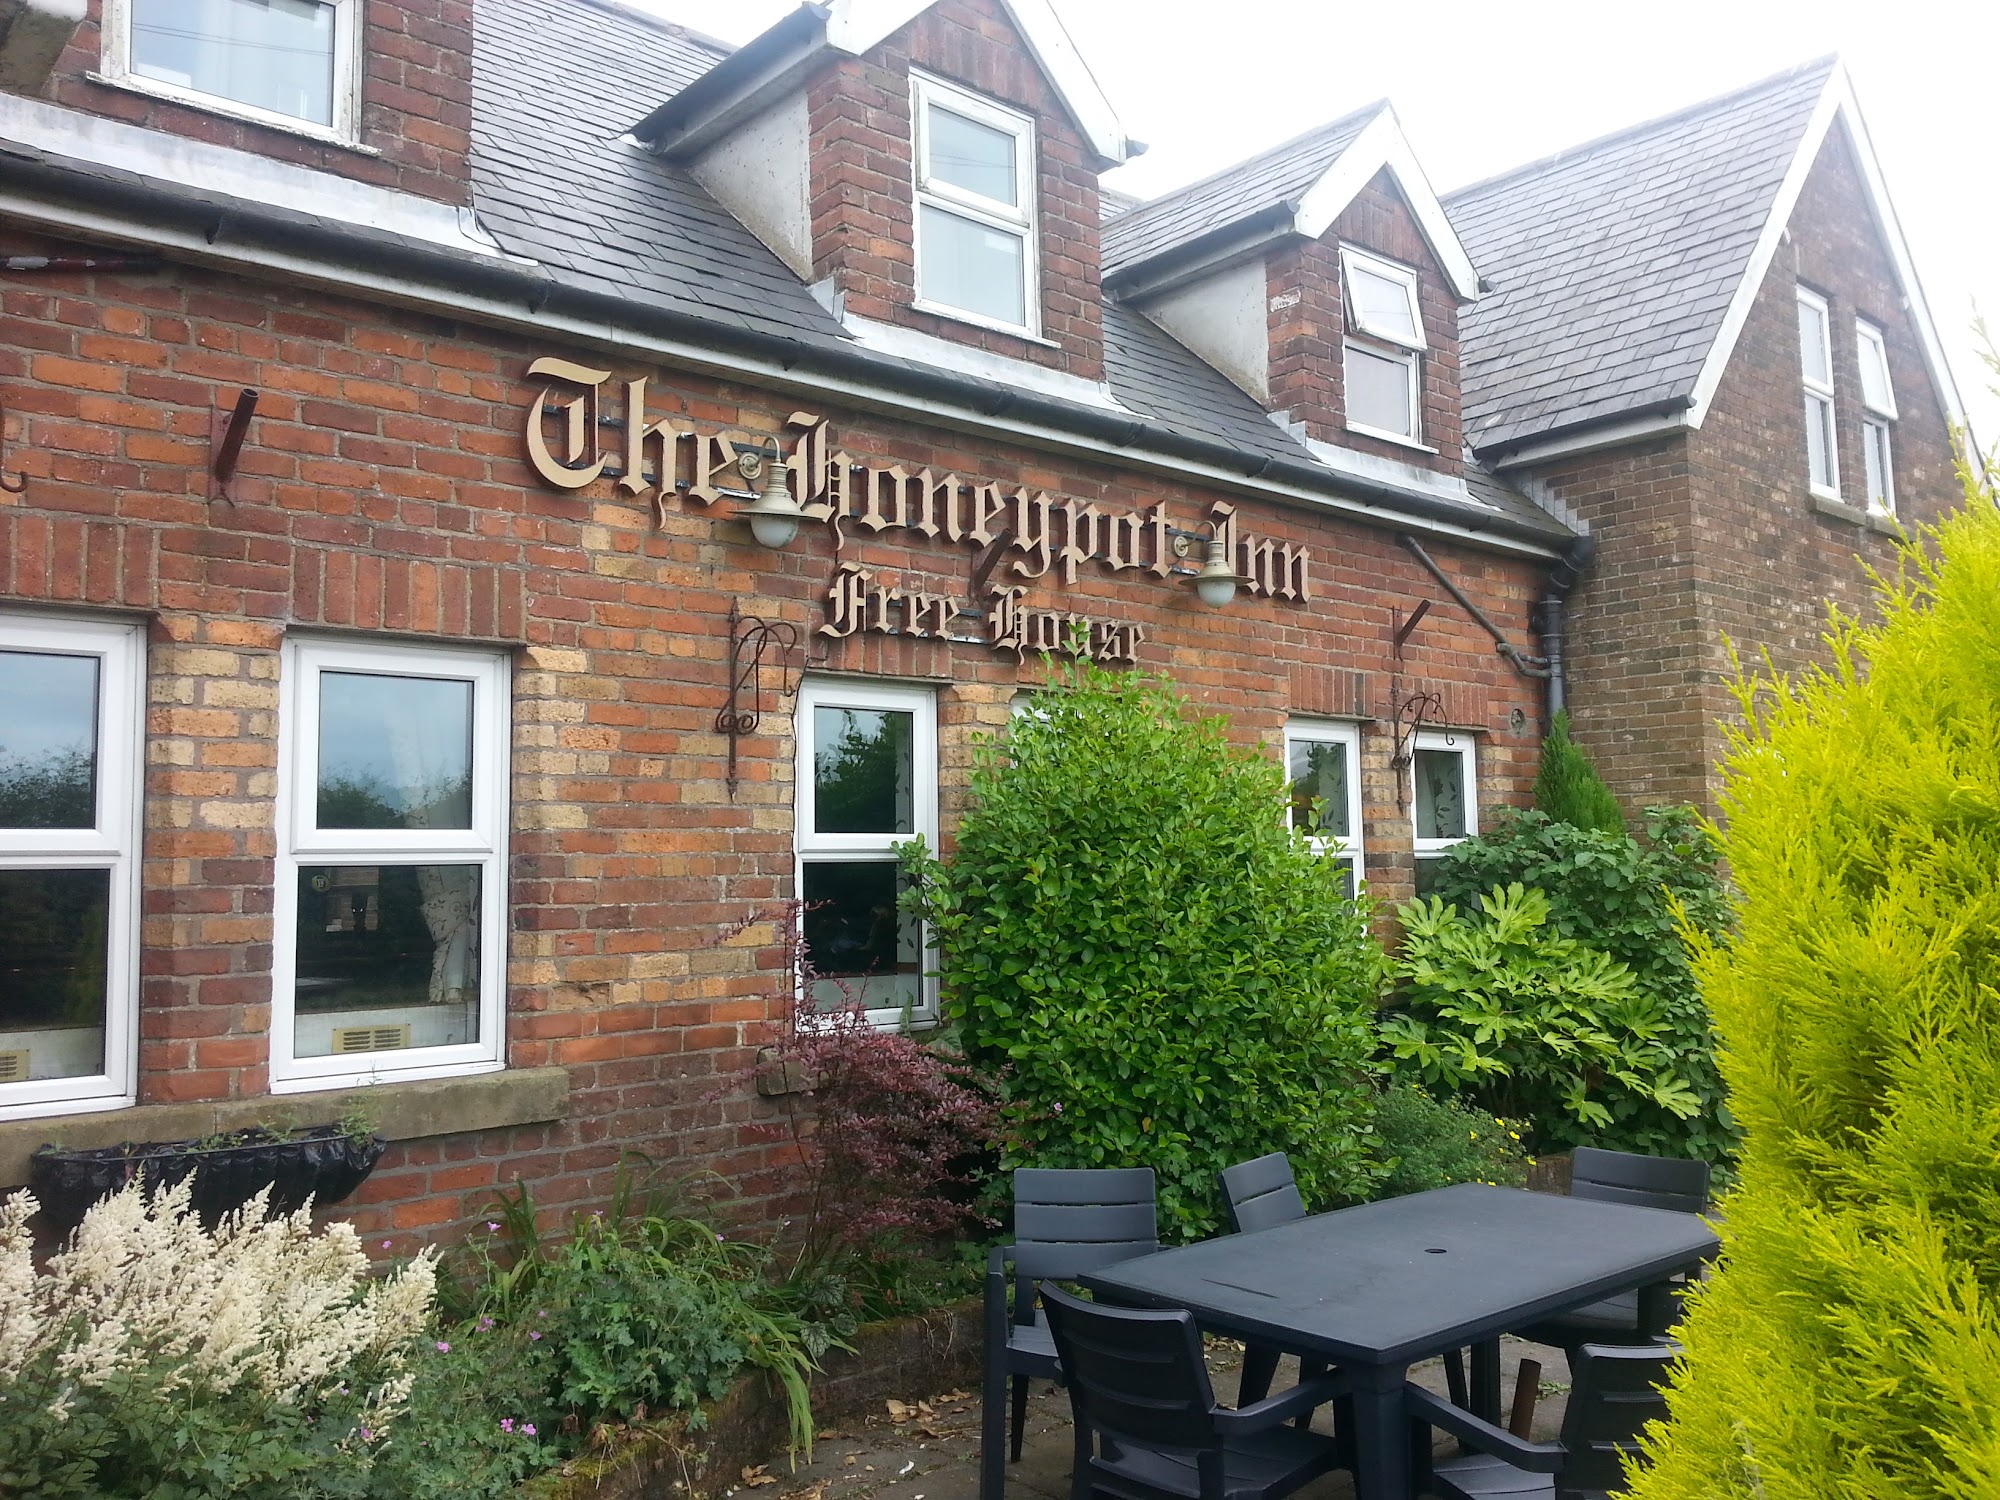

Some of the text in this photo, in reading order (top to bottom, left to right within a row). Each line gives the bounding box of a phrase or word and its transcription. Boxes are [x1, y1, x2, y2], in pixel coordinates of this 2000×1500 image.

[526, 356, 1311, 603] The Honeypot Inn
[817, 562, 1146, 666] Free House
